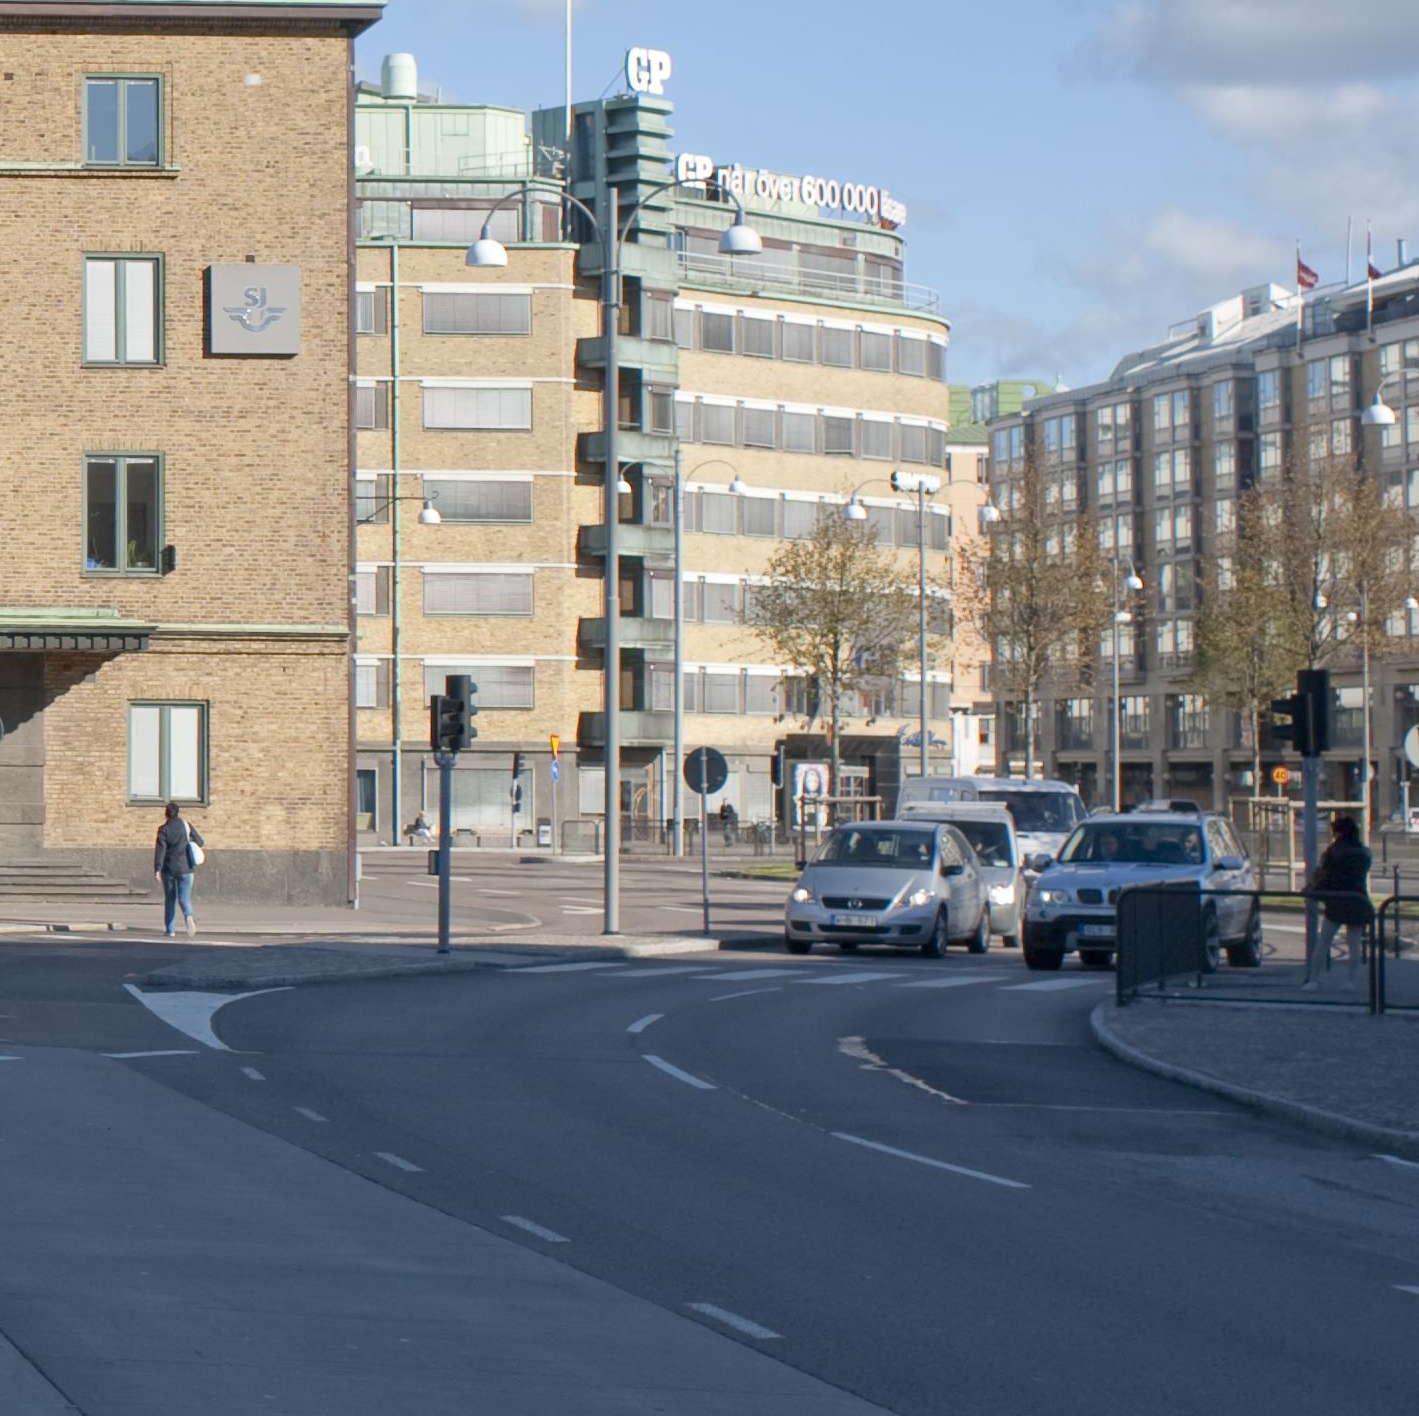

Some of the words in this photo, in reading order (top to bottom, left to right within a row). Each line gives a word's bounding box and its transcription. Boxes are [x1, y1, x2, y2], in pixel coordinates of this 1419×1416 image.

[626, 47, 671, 95] GP
[677, 152, 713, 188] GP
[717, 162, 752, 195] når
[756, 169, 800, 202] över
[801, 175, 841, 208] 600
[843, 182, 879, 215] 000
[243, 287, 268, 309] SJ
